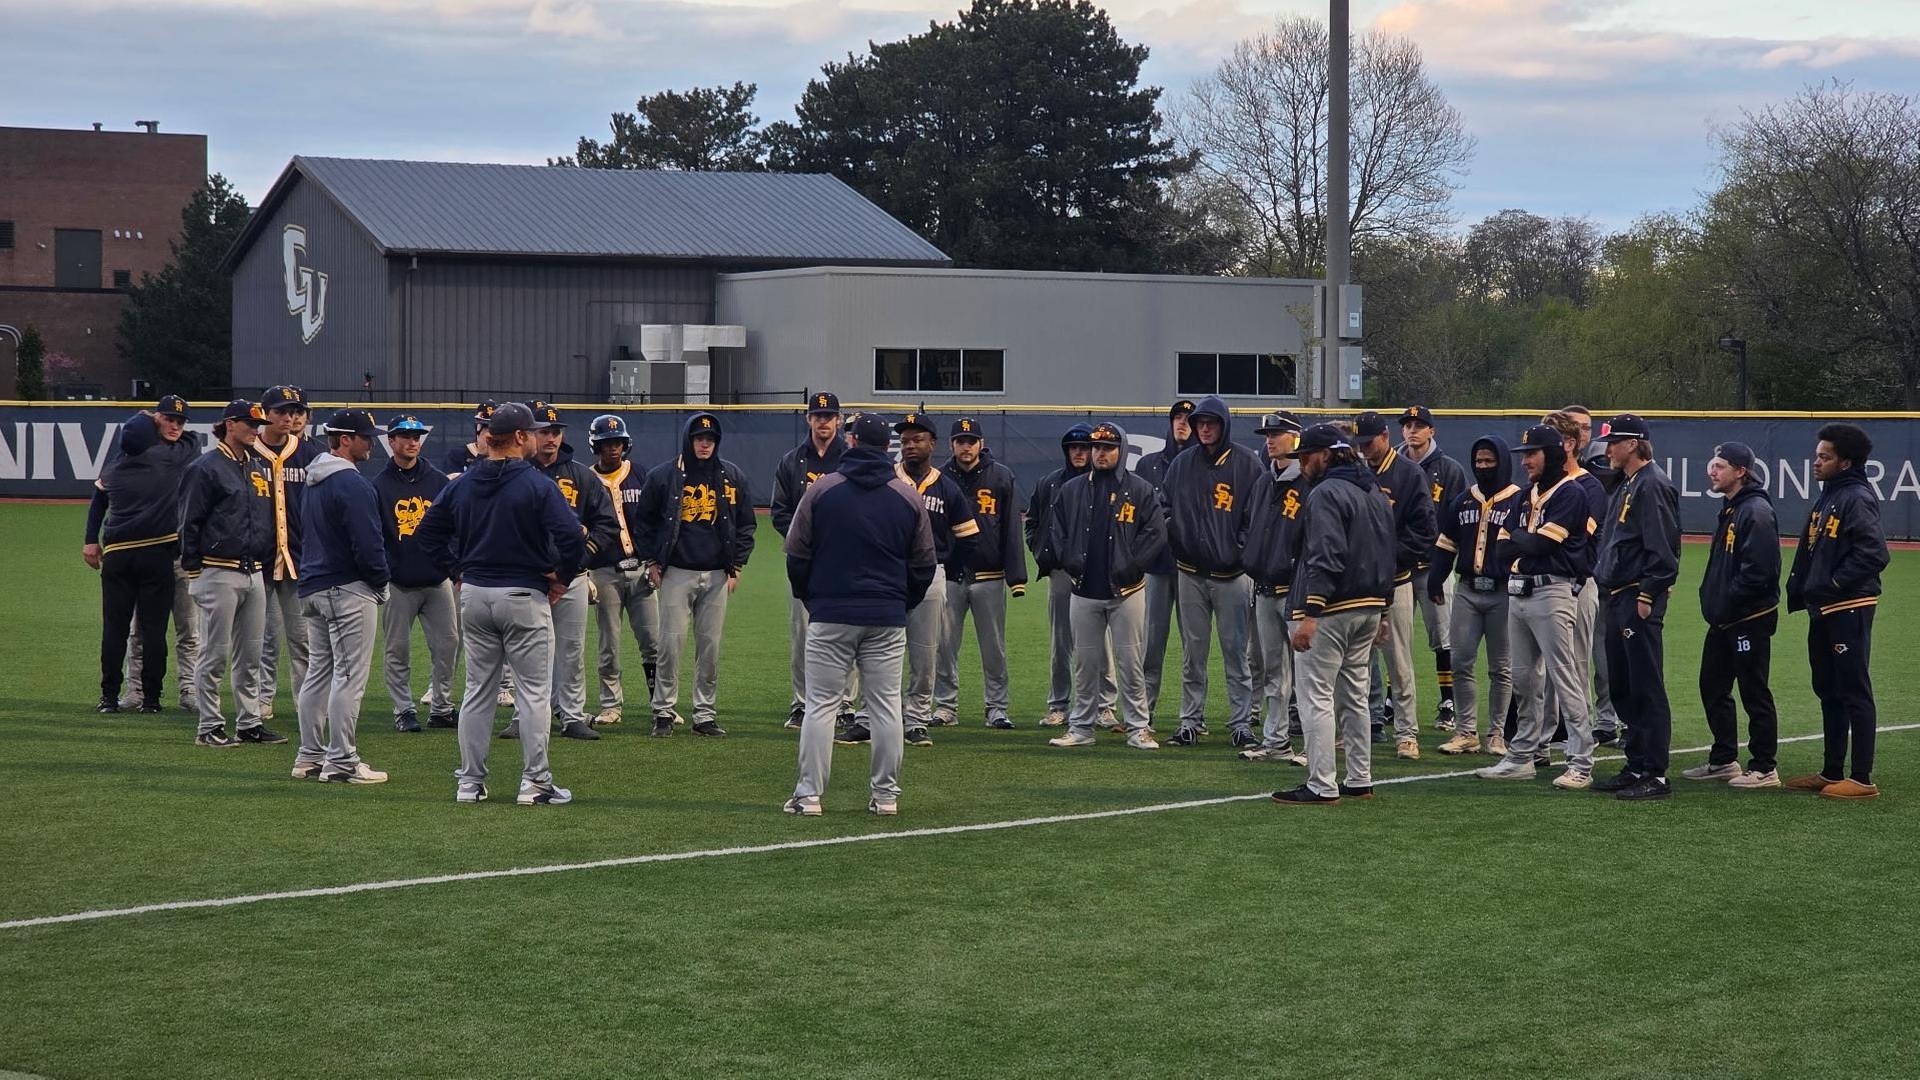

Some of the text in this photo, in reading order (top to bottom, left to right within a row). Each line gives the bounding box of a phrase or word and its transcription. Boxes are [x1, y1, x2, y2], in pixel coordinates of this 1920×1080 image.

[819, 395, 828, 408] SH
[962, 420, 971, 432] SH
[251, 471, 271, 498] SH
[977, 489, 997, 515] SH
[1215, 483, 1234, 513] SH
[1282, 489, 1301, 520] SH
[1737, 640, 1751, 652] 18
